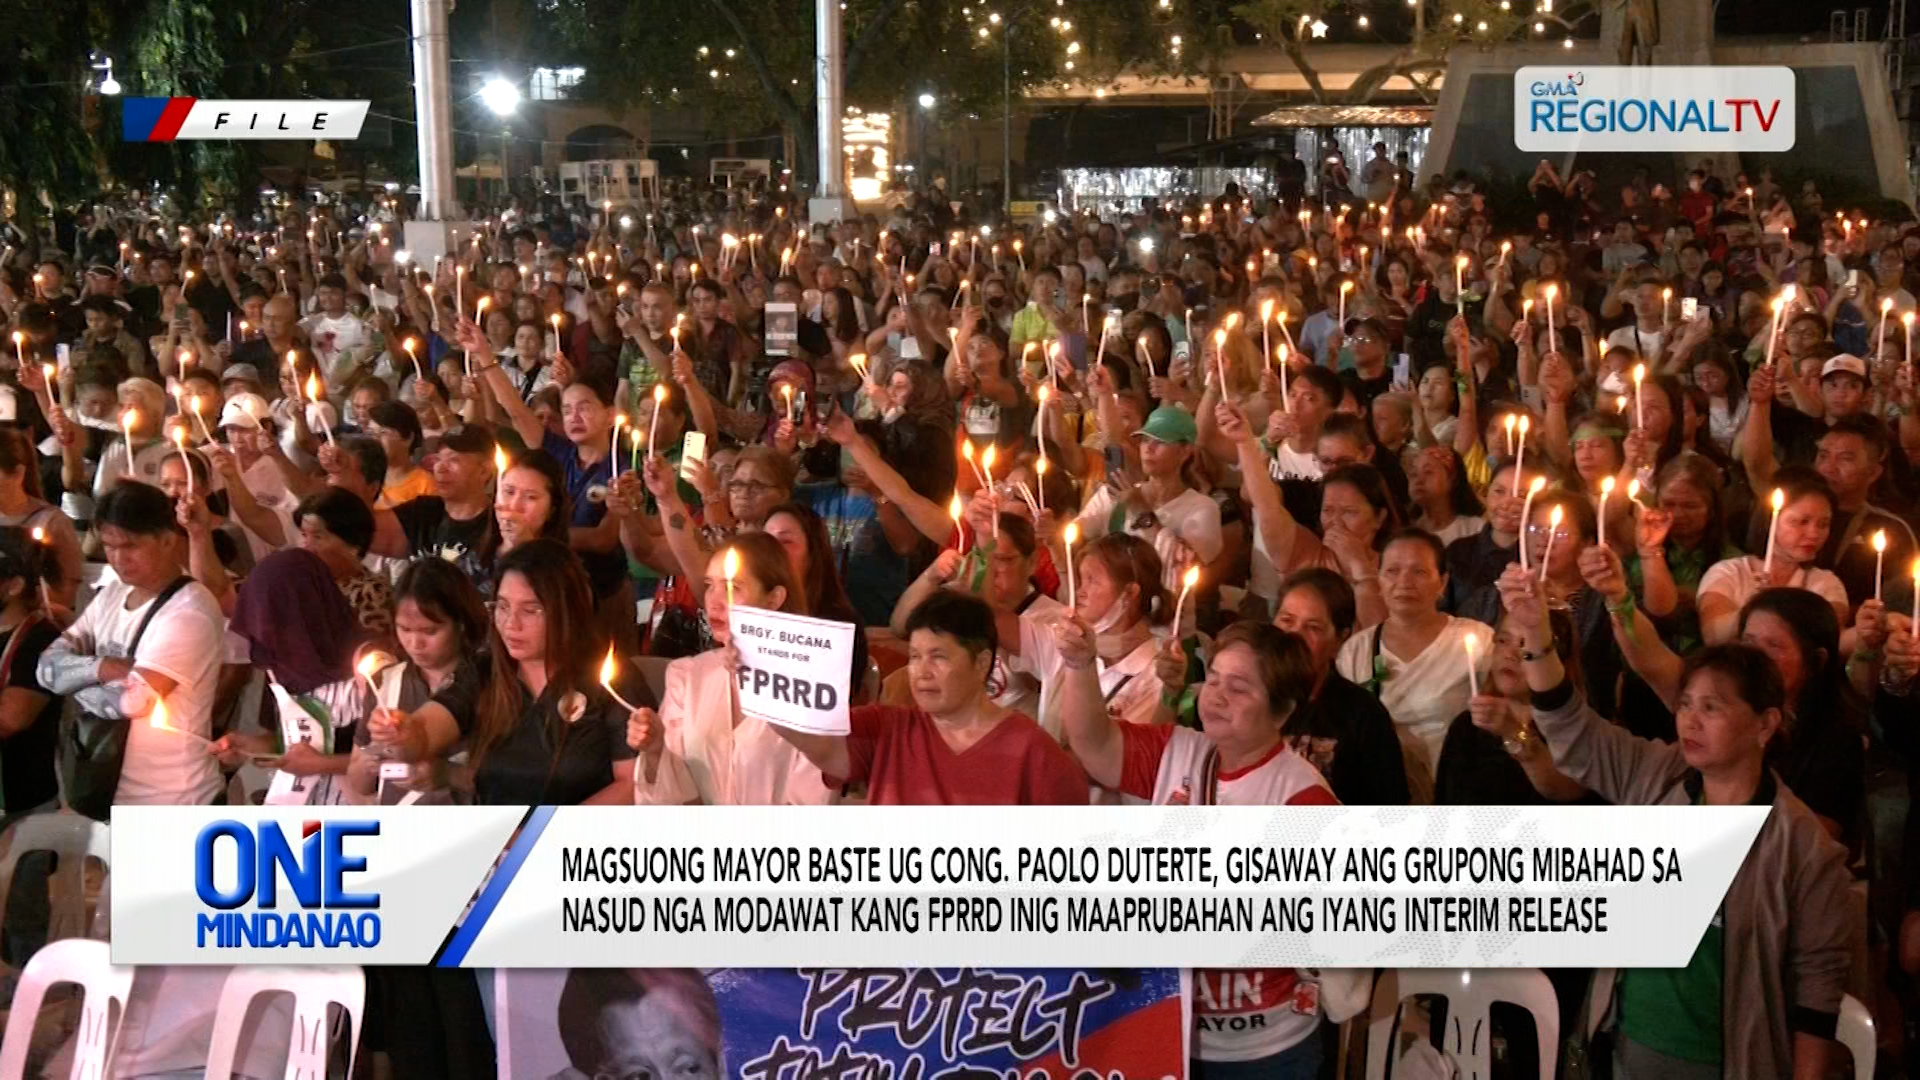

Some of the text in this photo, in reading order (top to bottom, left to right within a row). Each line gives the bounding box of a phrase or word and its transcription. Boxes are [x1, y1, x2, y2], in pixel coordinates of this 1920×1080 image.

[740, 623, 832, 650] BRGY. BUCANA
[738, 665, 838, 712] FPRRD
[799, 967, 1114, 1068] PROTECT
[1194, 1013, 1266, 1032] AYOR
